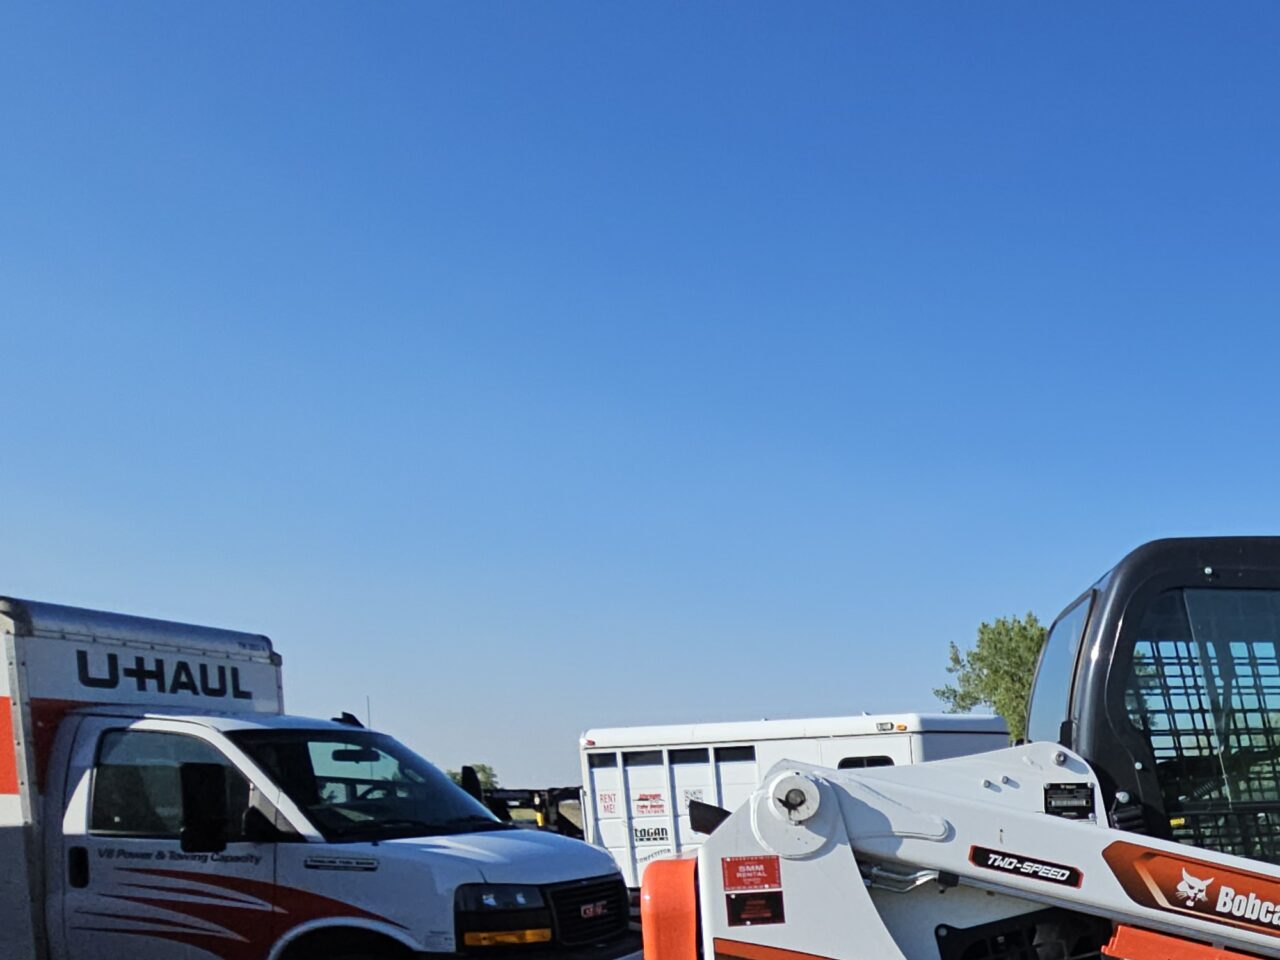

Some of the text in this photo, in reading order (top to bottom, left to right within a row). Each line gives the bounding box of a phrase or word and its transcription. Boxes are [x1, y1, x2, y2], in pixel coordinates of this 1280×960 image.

[76, 649, 253, 699] U-HAUL
[600, 793, 616, 803] RENT
[603, 804, 616, 813] ME!
[634, 828, 668, 838] LOGAN
[116, 849, 152, 860] Power
[155, 850, 166, 860] &
[169, 850, 208, 863] Towing
[211, 851, 262, 865] Capacity
[987, 854, 1070, 880] TWO-SPEED
